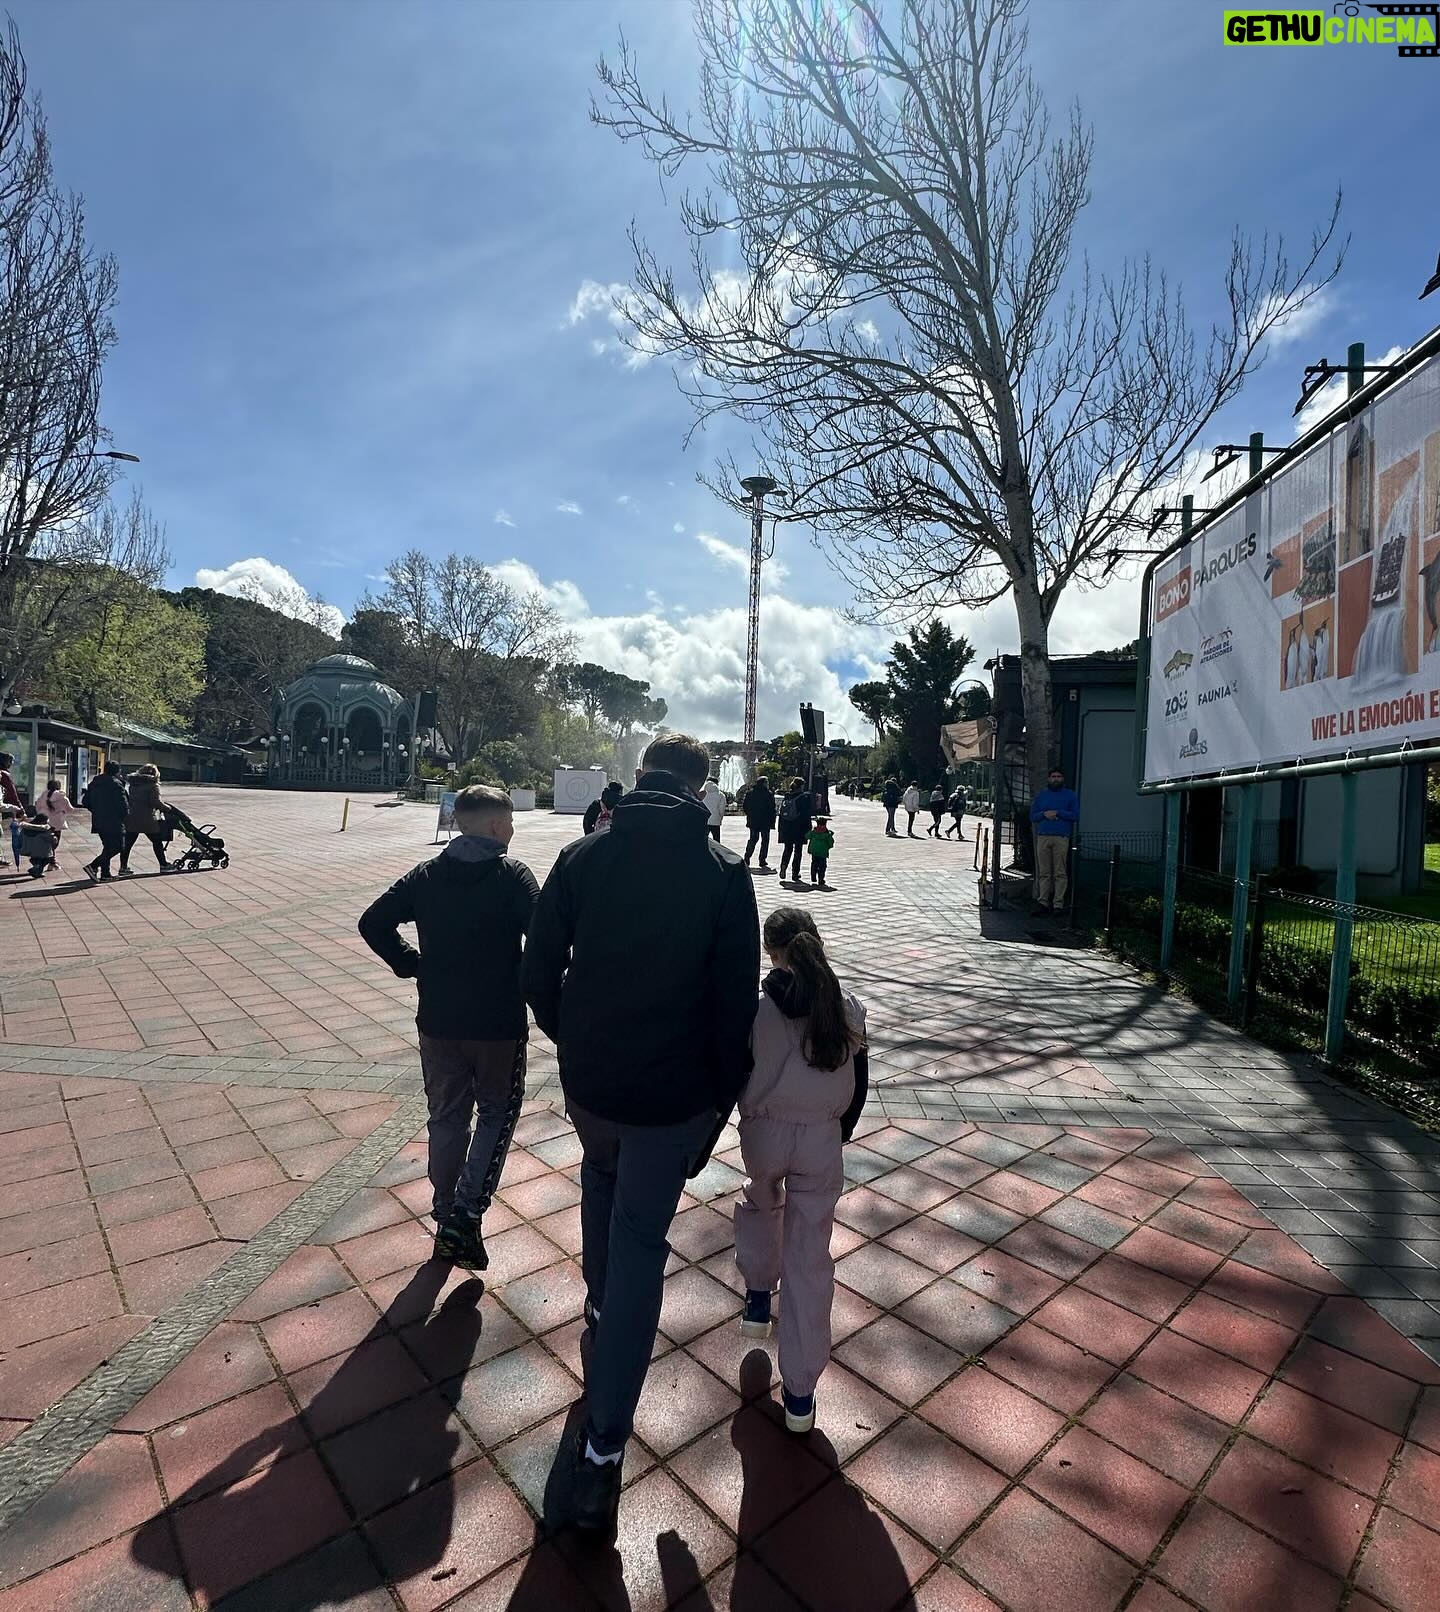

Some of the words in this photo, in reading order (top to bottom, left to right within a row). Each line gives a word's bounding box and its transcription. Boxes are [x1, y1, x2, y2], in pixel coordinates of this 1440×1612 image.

[1160, 579, 1188, 613] BONO
[1193, 533, 1257, 591] PARQUES
[1200, 646, 1233, 664] ATRACCIONES
[1198, 685, 1231, 706] FAUNIA
[1311, 714, 1337, 741] VIVE
[1340, 710, 1355, 736] LA
[1359, 689, 1425, 732] EMOCIÓN
